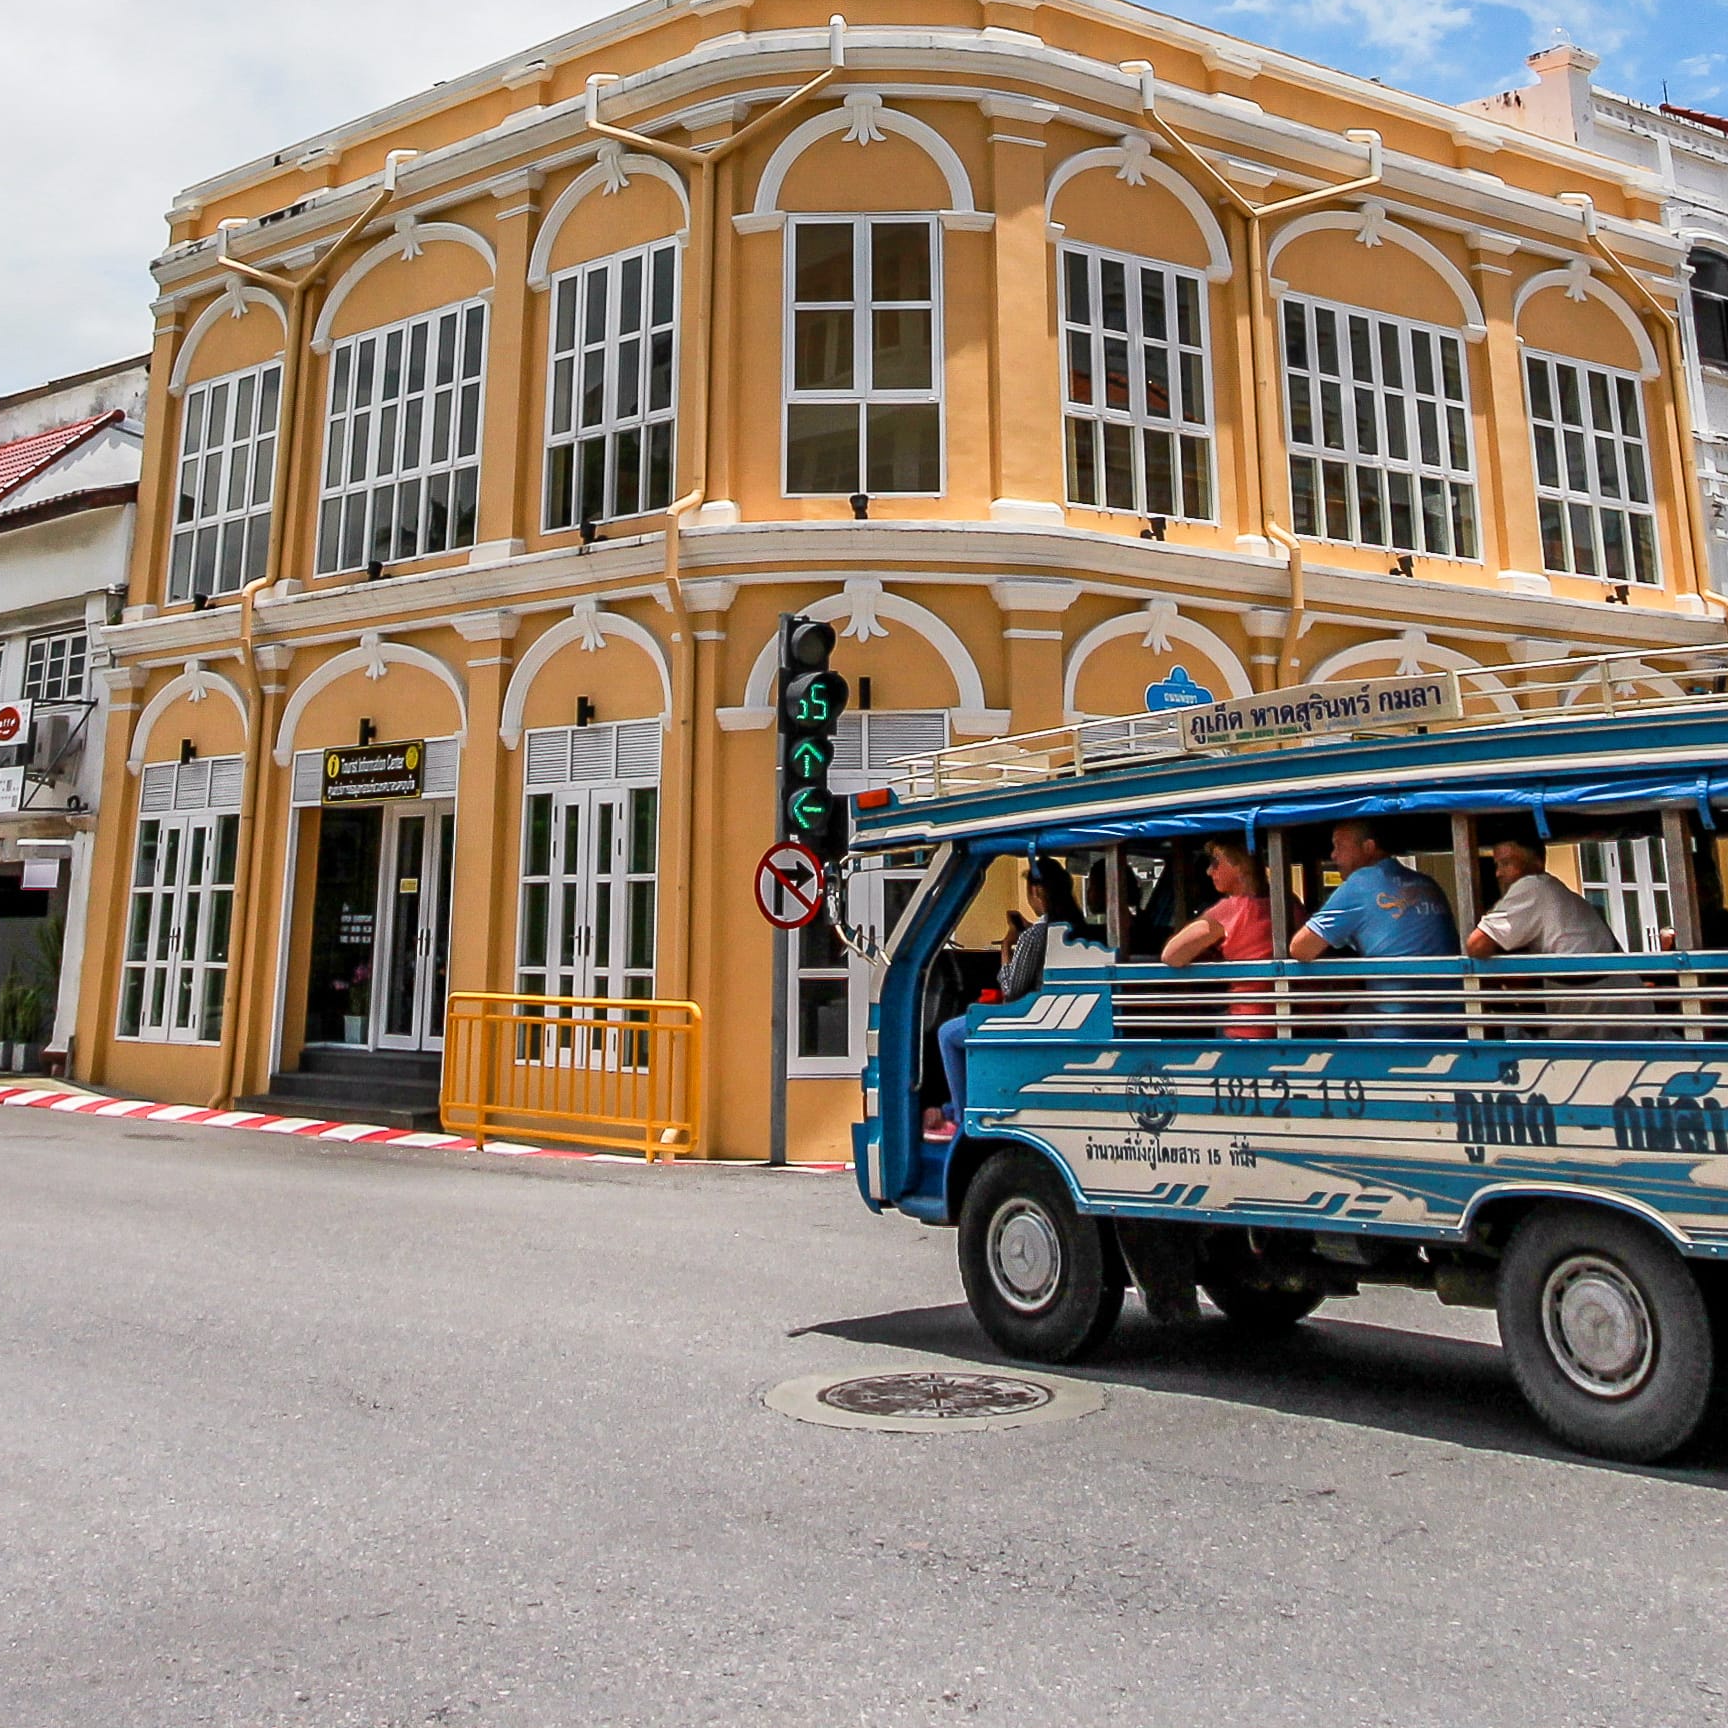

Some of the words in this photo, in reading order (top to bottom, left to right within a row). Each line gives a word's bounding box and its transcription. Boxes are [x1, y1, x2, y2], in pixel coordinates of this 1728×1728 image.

[1190, 703, 1243, 744] ภูเก็ต
[1249, 685, 1371, 732] หาดสุรินทร์
[1378, 683, 1442, 713] กมลา
[1085, 1132, 1201, 1170] จำนวนที่นั่งผู้โดยสาร
[1207, 1148, 1221, 1165] 15
